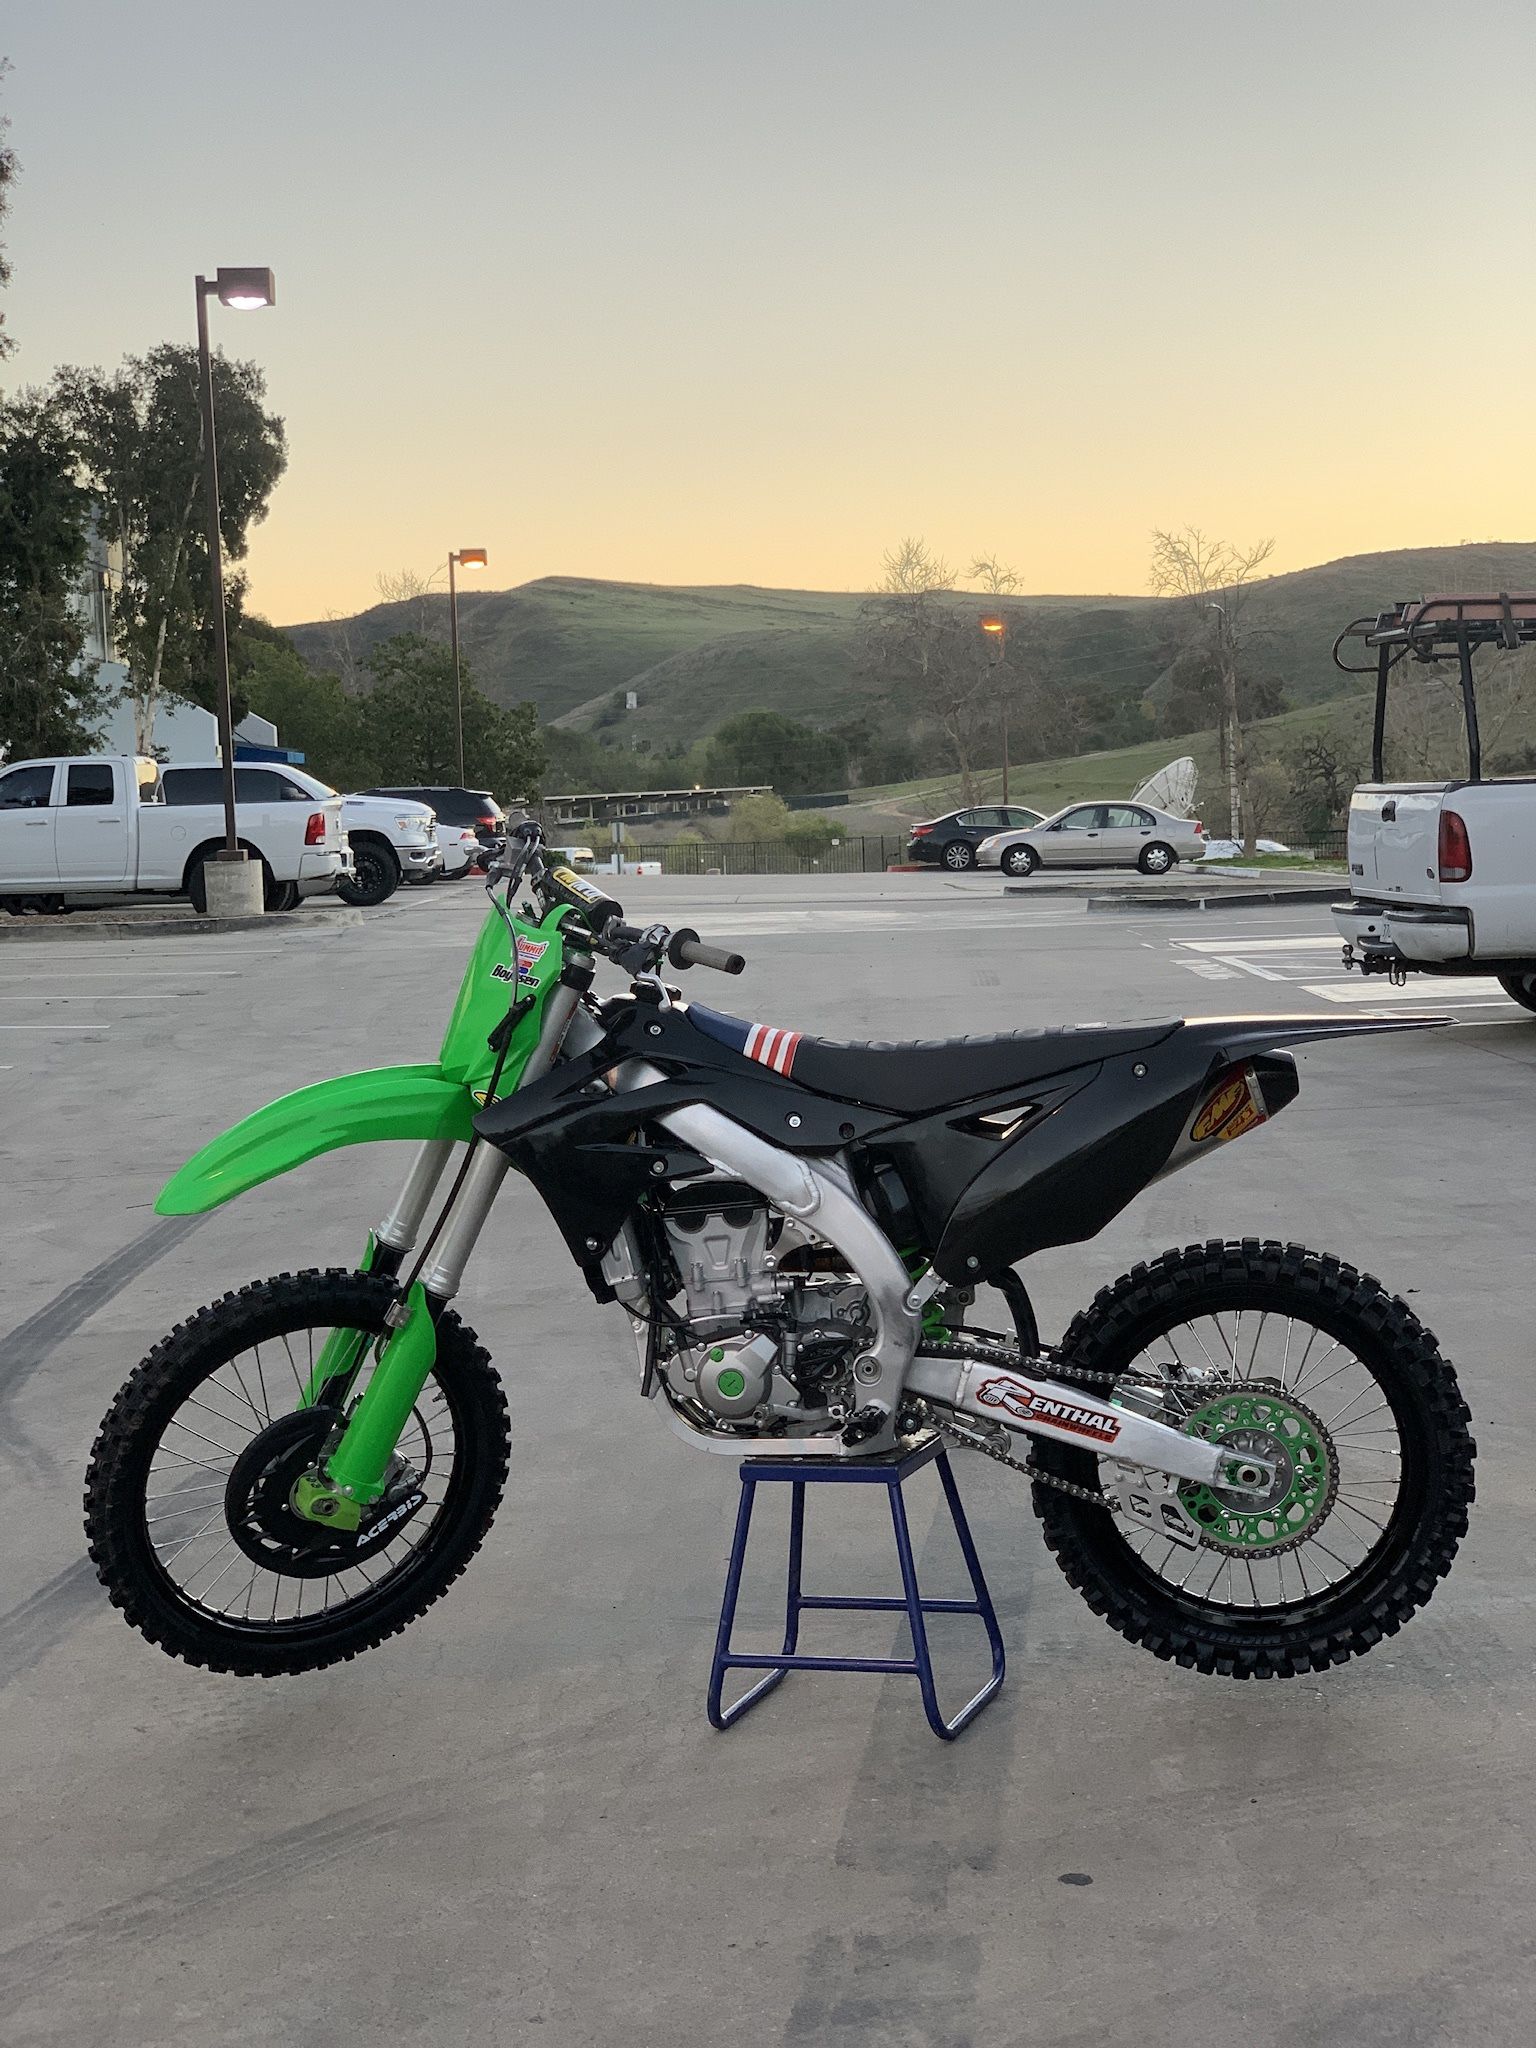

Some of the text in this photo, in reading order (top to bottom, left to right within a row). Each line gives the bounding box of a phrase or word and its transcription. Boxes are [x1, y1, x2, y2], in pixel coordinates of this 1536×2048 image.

[493, 964, 540, 987] Boysen
[1193, 1081, 1241, 1140] FMF
[983, 1381, 1118, 1433] RENTHAL
